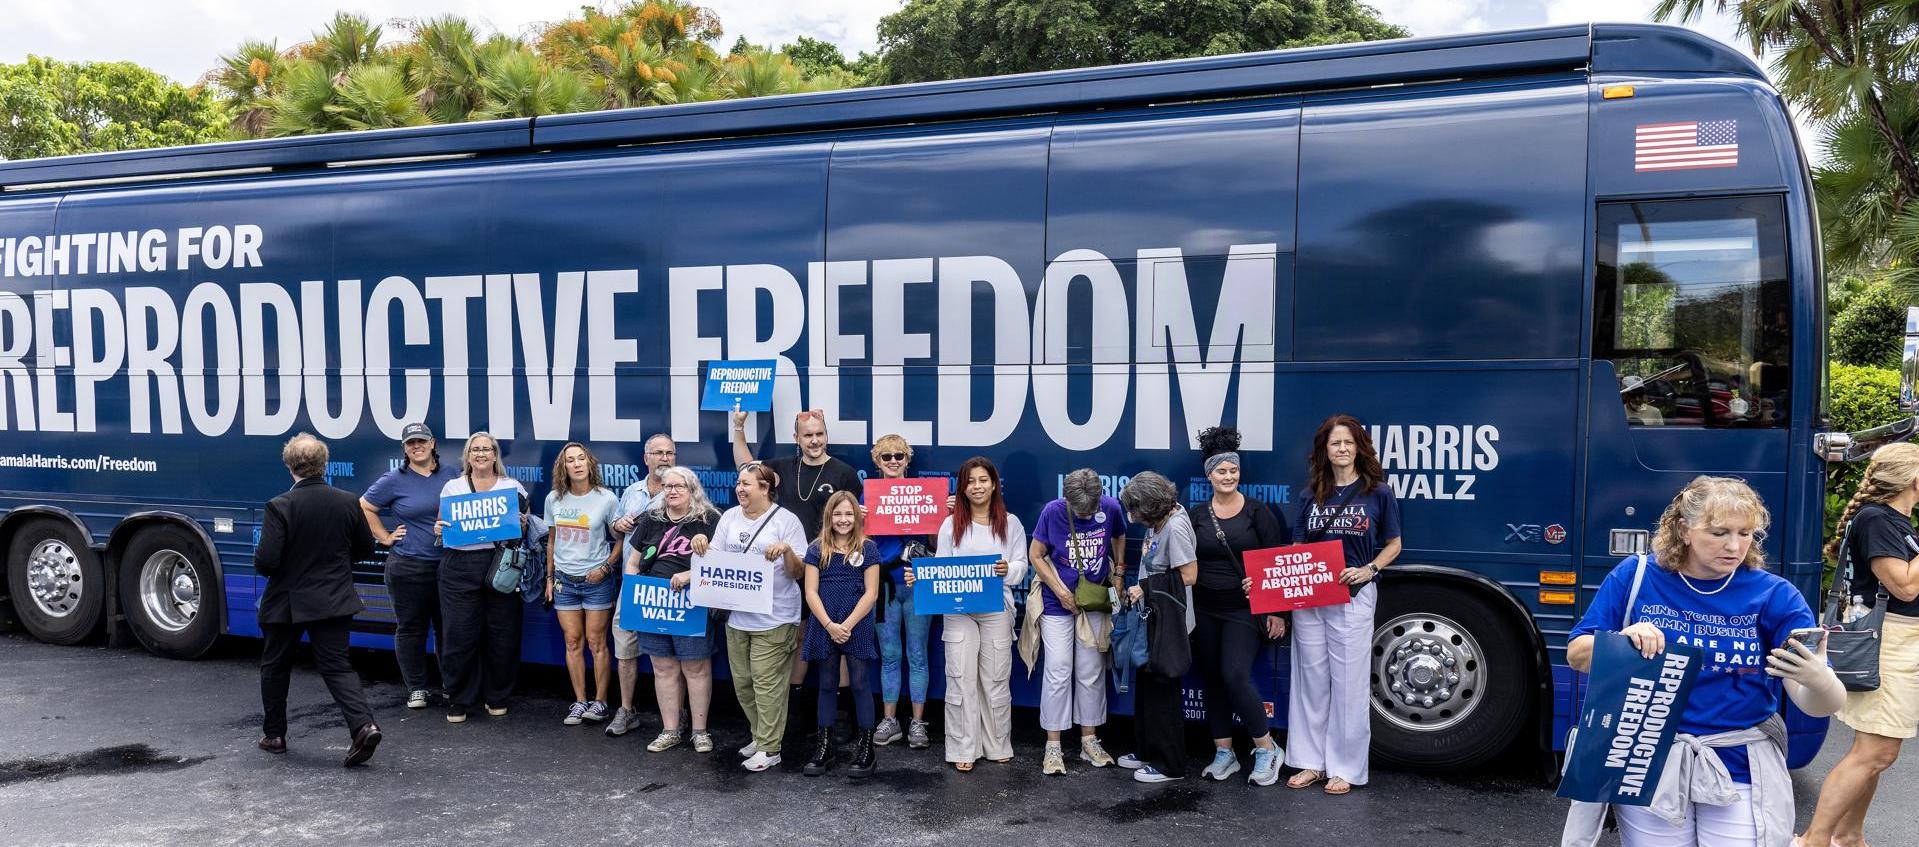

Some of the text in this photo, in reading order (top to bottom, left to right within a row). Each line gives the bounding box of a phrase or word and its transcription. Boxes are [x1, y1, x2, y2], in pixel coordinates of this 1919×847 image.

[0, 224, 263, 277] IGHTING FOR
[0, 243, 1277, 452] REPRODUCTIVE FREEDOM
[710, 368, 772, 380] REPRODUCTIVE
[720, 381, 759, 394] FREEDOM
[890, 485, 923, 495] STOP
[879, 494, 934, 505] TRUMP'S
[451, 496, 508, 521] HARRIS
[875, 504, 938, 515] ABORTION
[460, 516, 501, 532] WALZ
[894, 514, 920, 524] BAN
[1308, 515, 1370, 530] HARIS 24
[1274, 551, 1313, 566] STOP
[700, 566, 764, 584] HARRIS
[1263, 561, 1328, 579] TRUMP'S
[699, 579, 763, 592] for PRESIDENT
[933, 579, 984, 594] FREEDOM
[1261, 571, 1334, 590] ABORTION
[1283, 585, 1314, 599] BAN
[641, 606, 686, 622] WALZ
[1641, 604, 1679, 617] MIND
[1682, 610, 1727, 626] YOUR
[1676, 635, 1718, 648] ARE
[1184, 708, 1207, 720] SDOT
[1604, 676, 1655, 768] FREEDOM
[1617, 652, 1690, 797] REPRODUCTIVE
